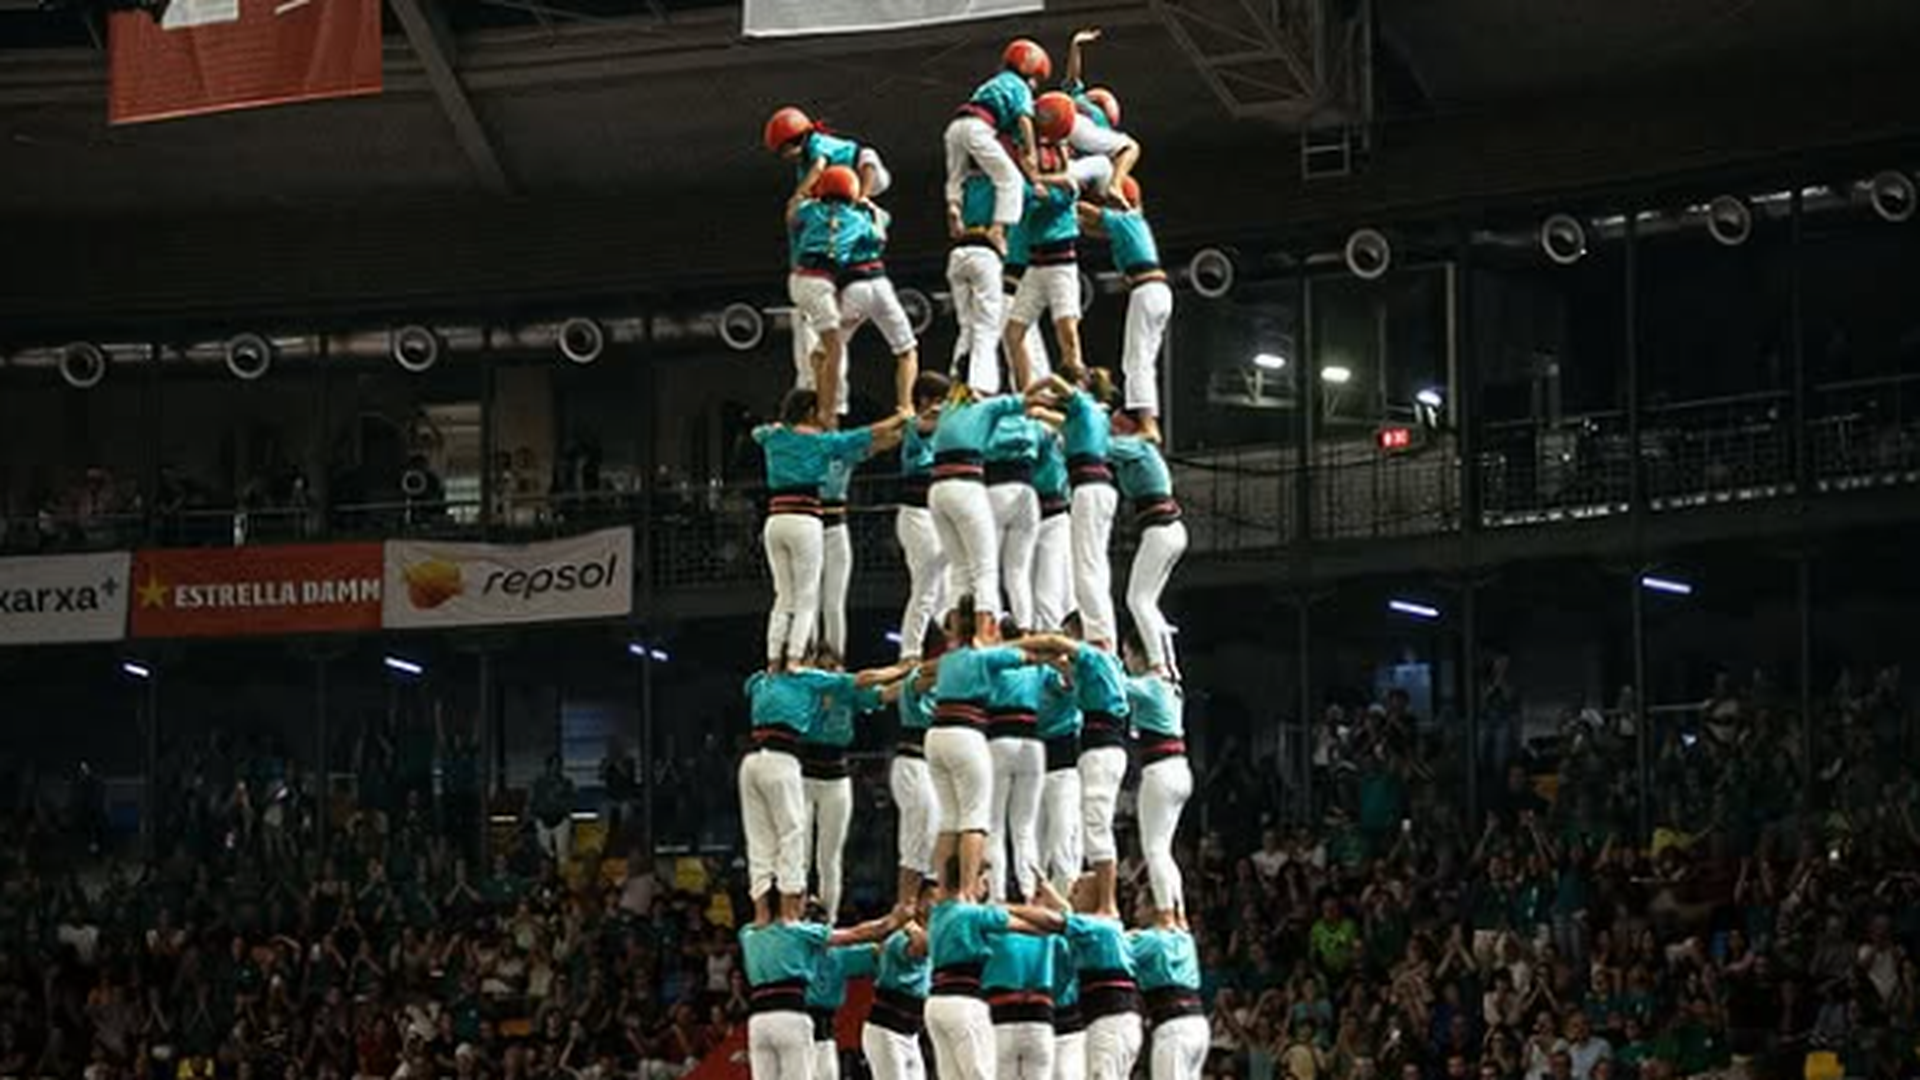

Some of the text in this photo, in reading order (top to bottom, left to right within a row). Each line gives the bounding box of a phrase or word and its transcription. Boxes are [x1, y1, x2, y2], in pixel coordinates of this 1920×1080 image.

[174, 579, 381, 607] ESTRELLA DAMM
[482, 552, 617, 600] repsol
